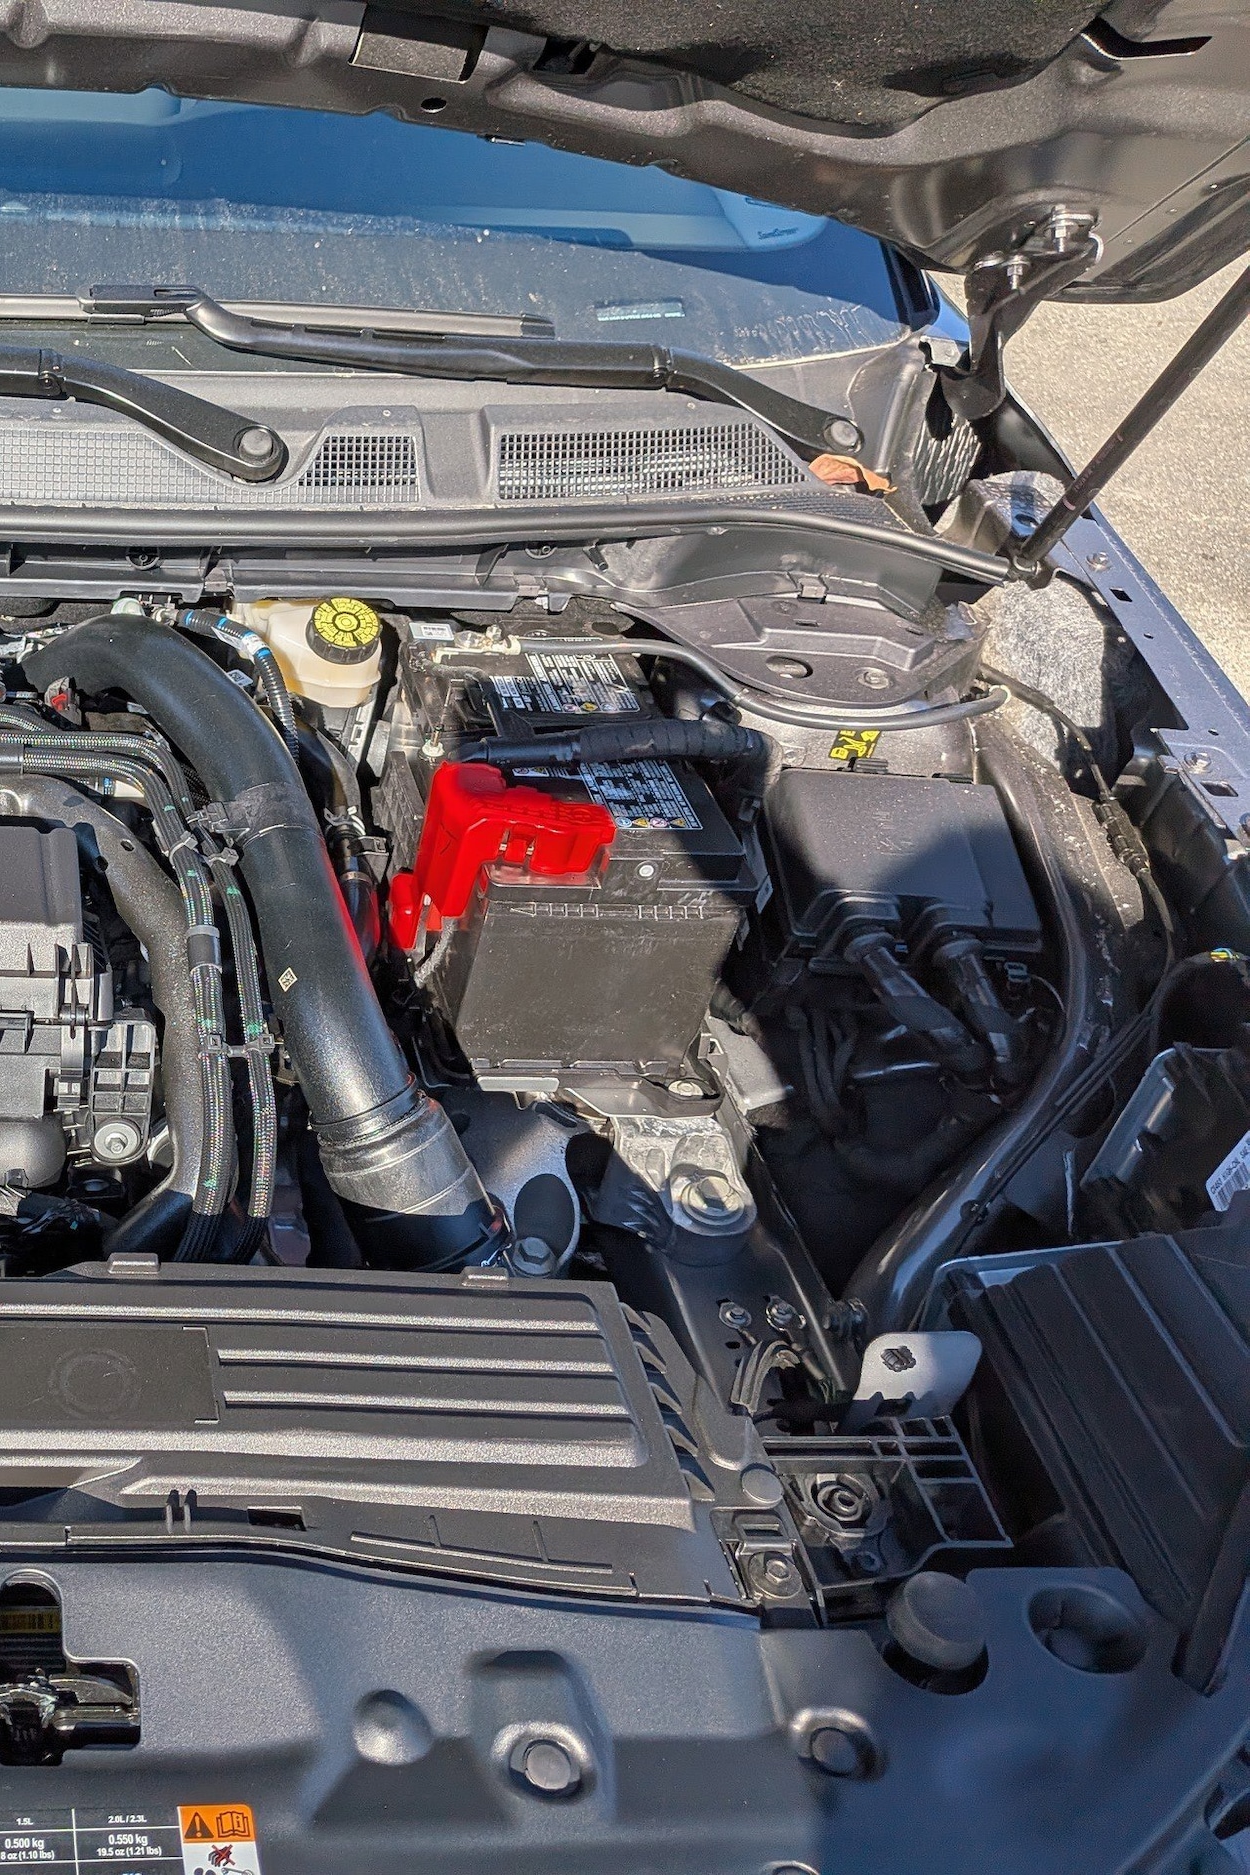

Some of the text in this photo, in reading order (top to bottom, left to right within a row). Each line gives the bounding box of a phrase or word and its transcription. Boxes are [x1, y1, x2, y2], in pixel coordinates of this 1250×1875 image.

[15, 1817, 34, 1826] 1.5L
[107, 1815, 125, 1824] 2.0L
[130, 1814, 147, 1823] 2.3L
[4, 1837, 45, 1851] 0.500 kg
[108, 1833, 148, 1847] 0.550 kg
[7, 1852, 18, 1861] oz
[18, 1850, 38, 1861] (1.10
[38, 1849, 55, 1861] lbs)
[96, 1845, 162, 1857] 19.5 oz (1.21 lbs)
